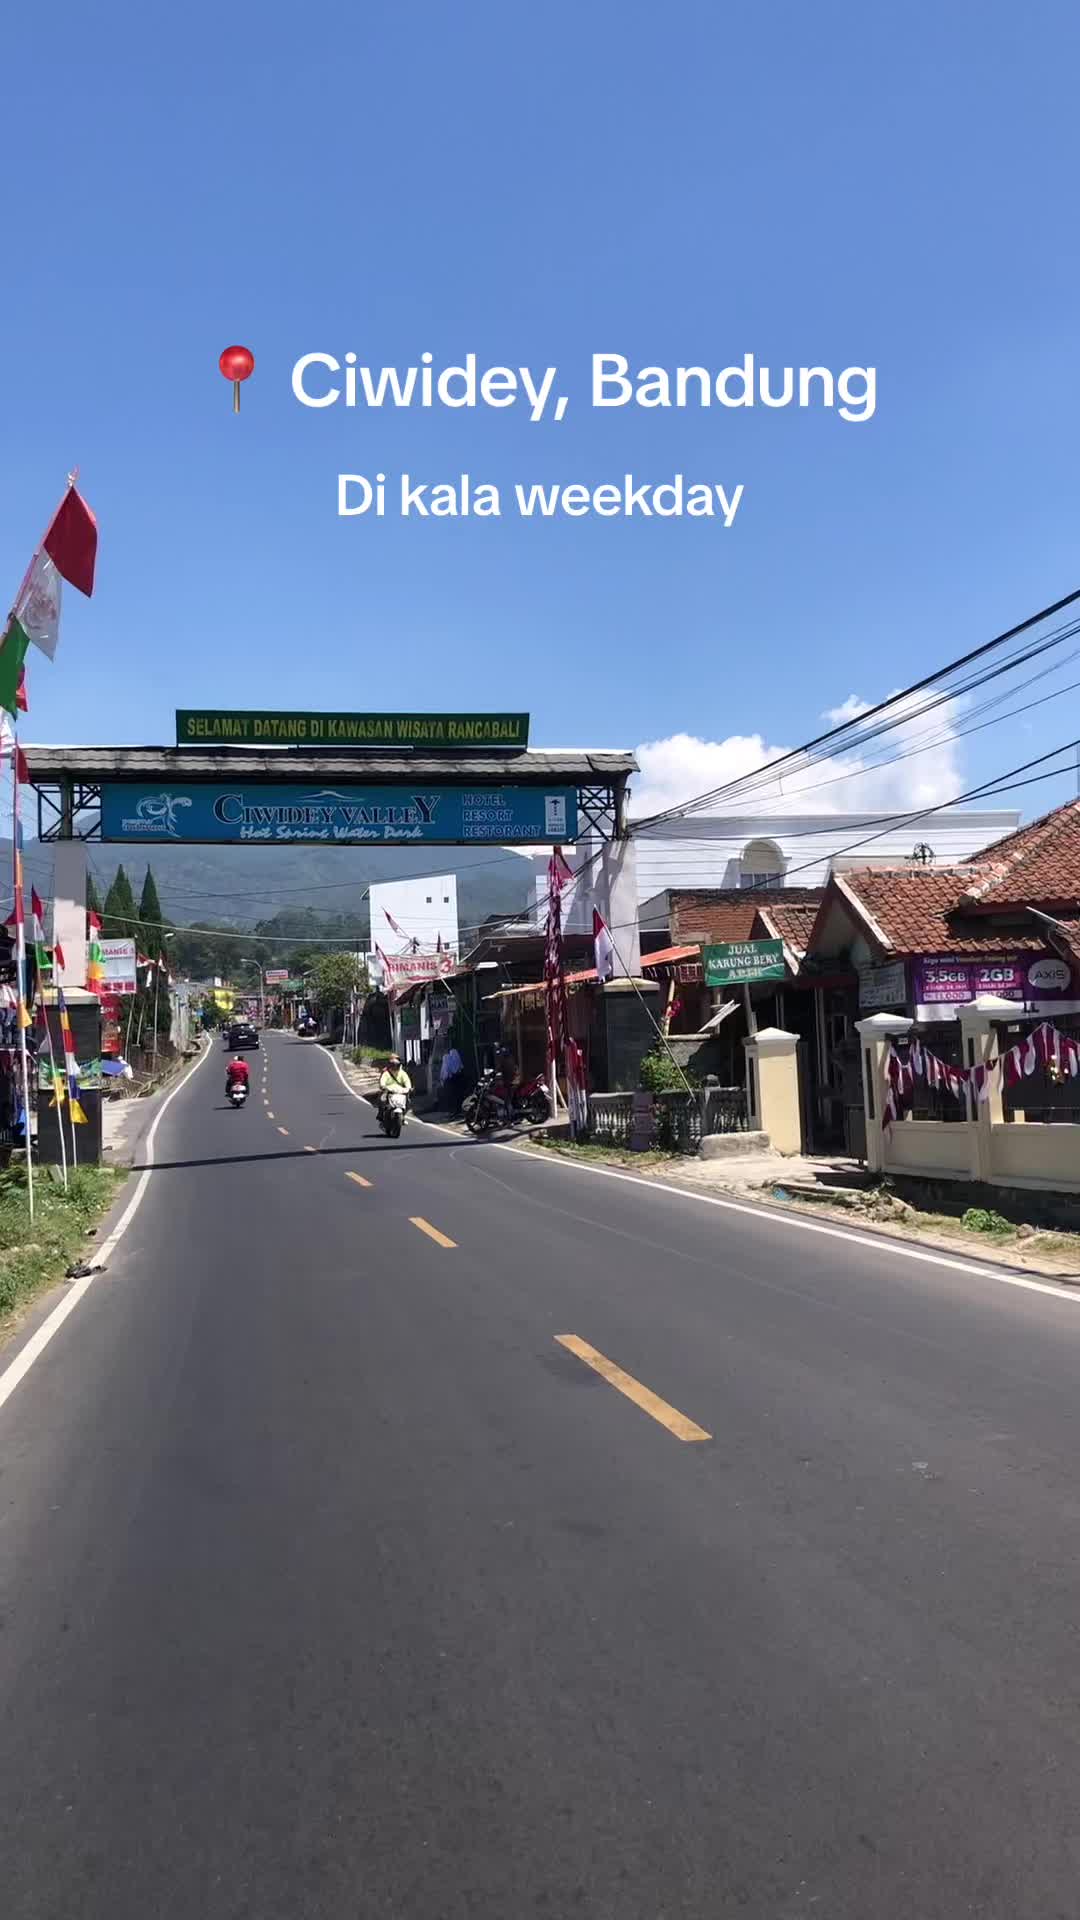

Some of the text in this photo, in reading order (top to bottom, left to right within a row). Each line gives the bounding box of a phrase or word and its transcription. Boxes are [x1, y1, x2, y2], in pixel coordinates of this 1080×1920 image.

[187, 718, 520, 738] SELAMAT DATANG DI KAWASAN WISATA RANCABALI
[463, 793, 507, 806] HOTEL
[463, 809, 513, 822] RESORT
[240, 825, 272, 839] Hot
[333, 826, 380, 839] Water
[384, 825, 424, 839] Park
[463, 825, 541, 838] RESTORANT
[728, 944, 757, 955] JUAL
[440, 959, 452, 973] 3
[709, 957, 752, 969] KARUNG
[980, 968, 1014, 982] 2GB
[1035, 969, 1064, 980] AXIS
